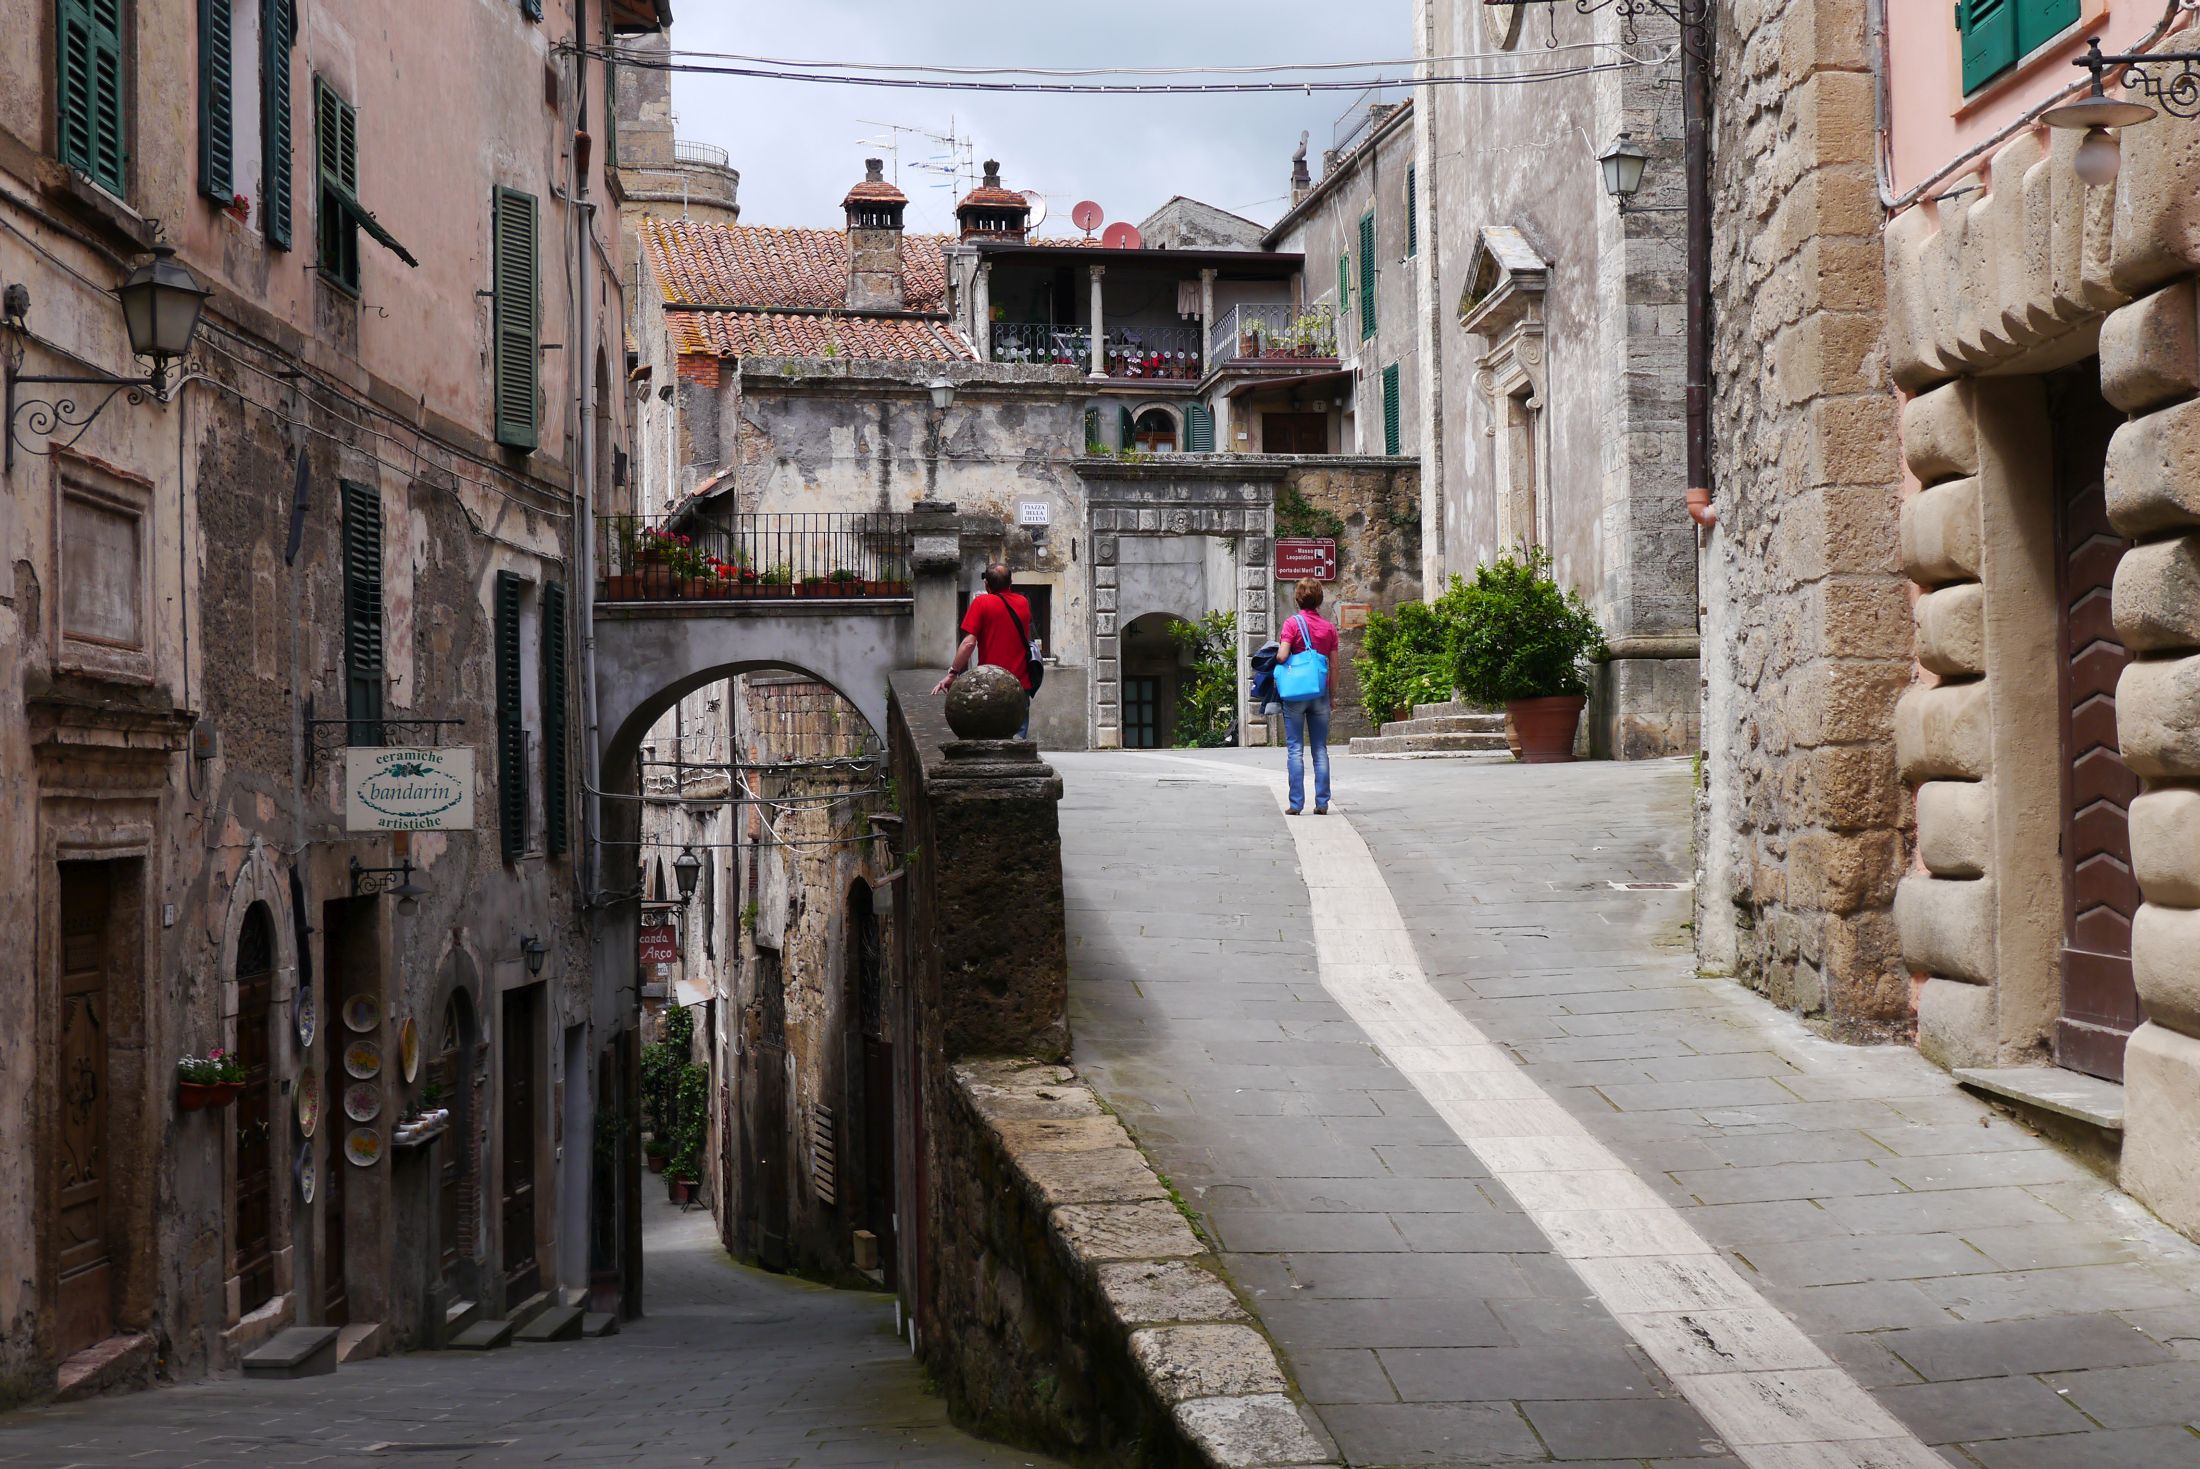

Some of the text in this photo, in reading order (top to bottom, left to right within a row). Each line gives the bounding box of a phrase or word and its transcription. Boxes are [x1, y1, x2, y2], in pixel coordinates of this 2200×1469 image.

[376, 751, 443, 765] ceramiche
[370, 783, 450, 801] bandarin
[378, 816, 442, 830] artistiche
[639, 929, 669, 943] canda
